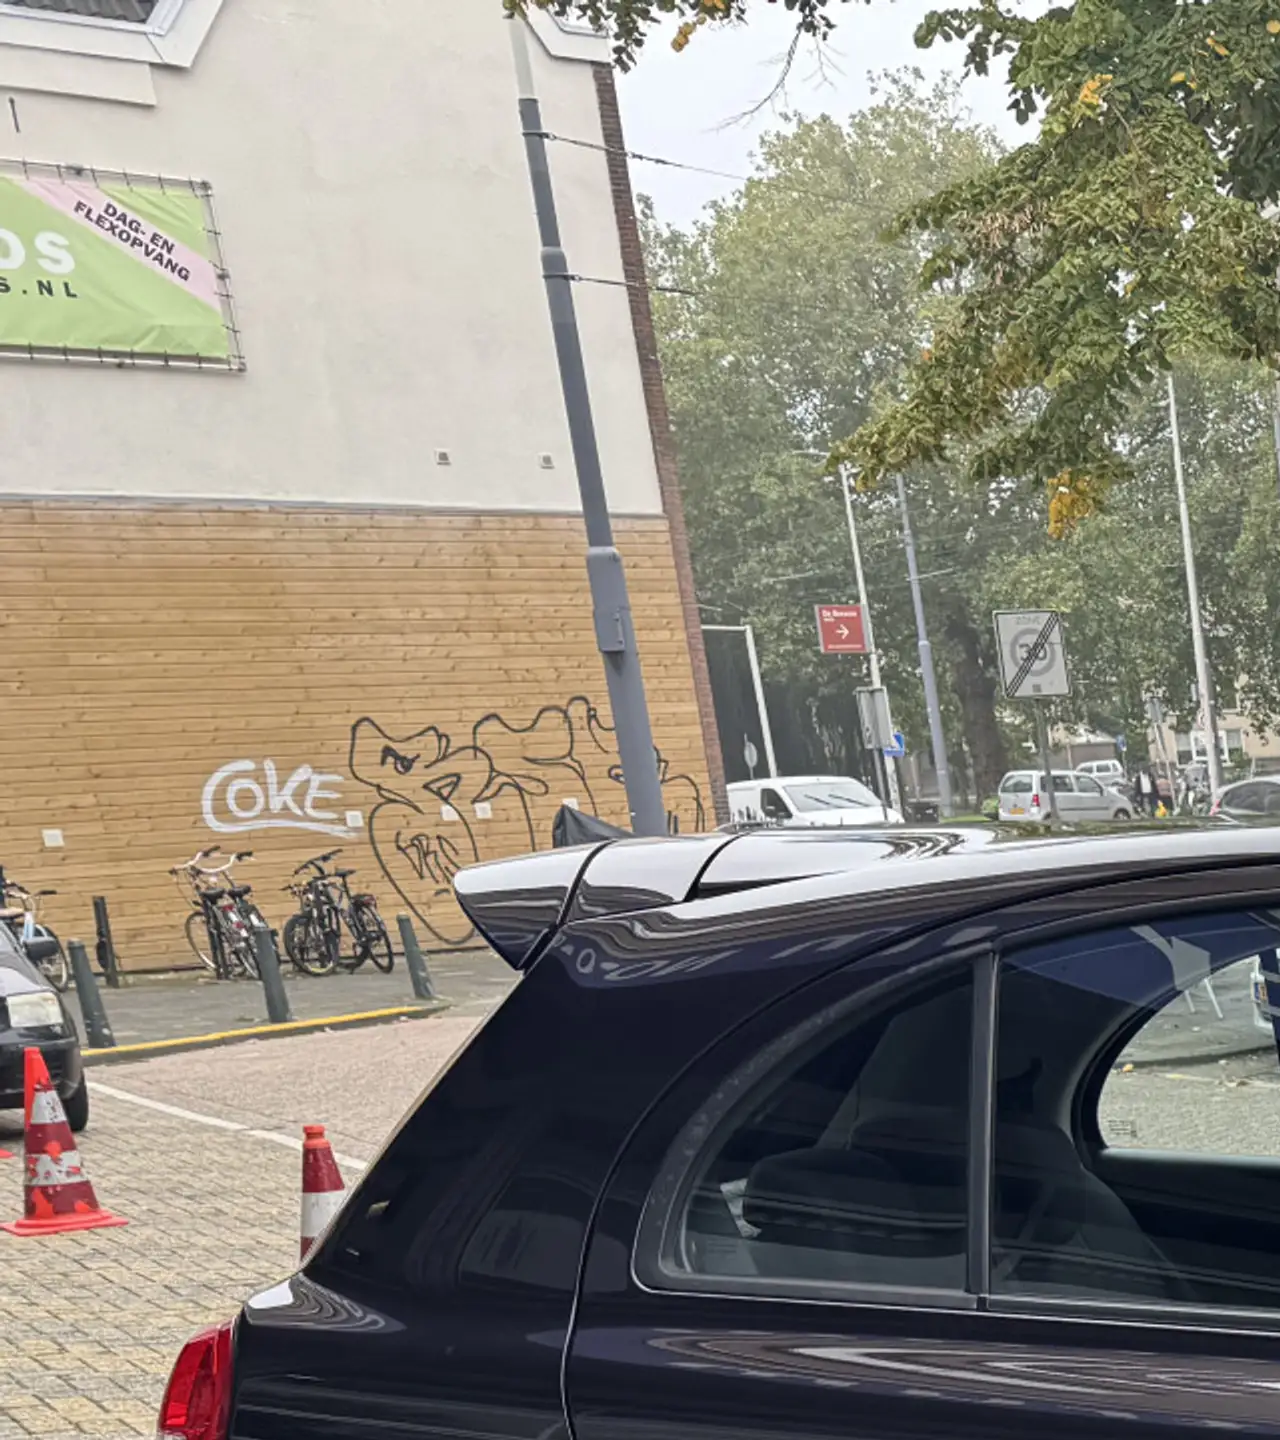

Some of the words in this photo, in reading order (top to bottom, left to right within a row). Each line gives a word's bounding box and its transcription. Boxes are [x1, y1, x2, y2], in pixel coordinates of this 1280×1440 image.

[73, 200, 191, 282] FLEXOPVANG
[102, 201, 146, 235] DAG-
[150, 230, 175, 255] EN
